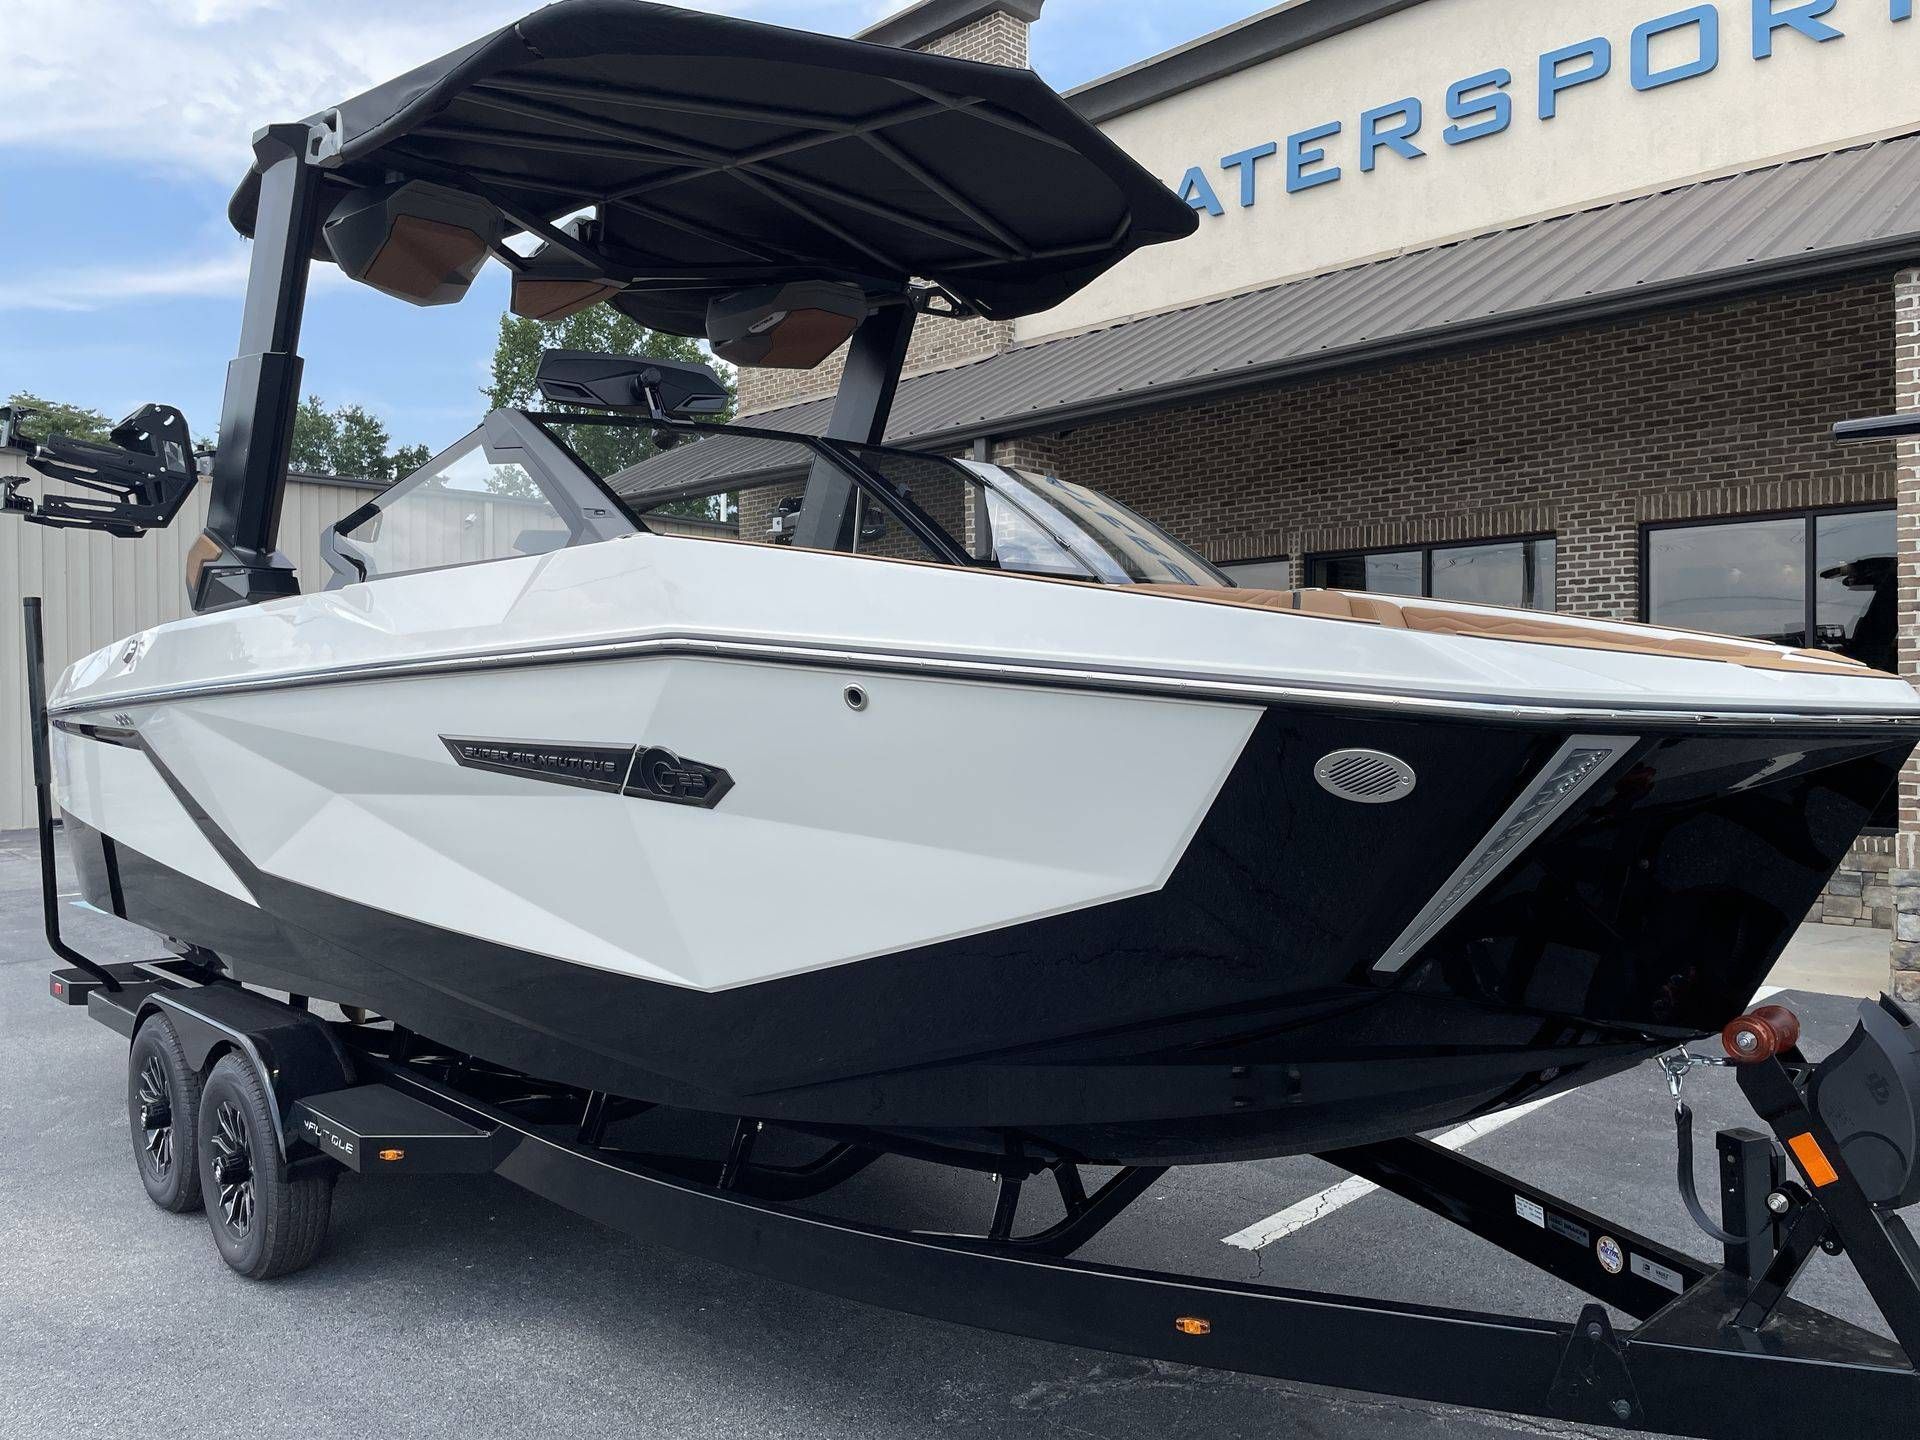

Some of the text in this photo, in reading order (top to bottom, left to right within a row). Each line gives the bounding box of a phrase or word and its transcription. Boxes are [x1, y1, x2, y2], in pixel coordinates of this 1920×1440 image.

[1176, 0, 1913, 216] ATERSPOR
[465, 746, 615, 772] SUPER AIR NAUTIQUE
